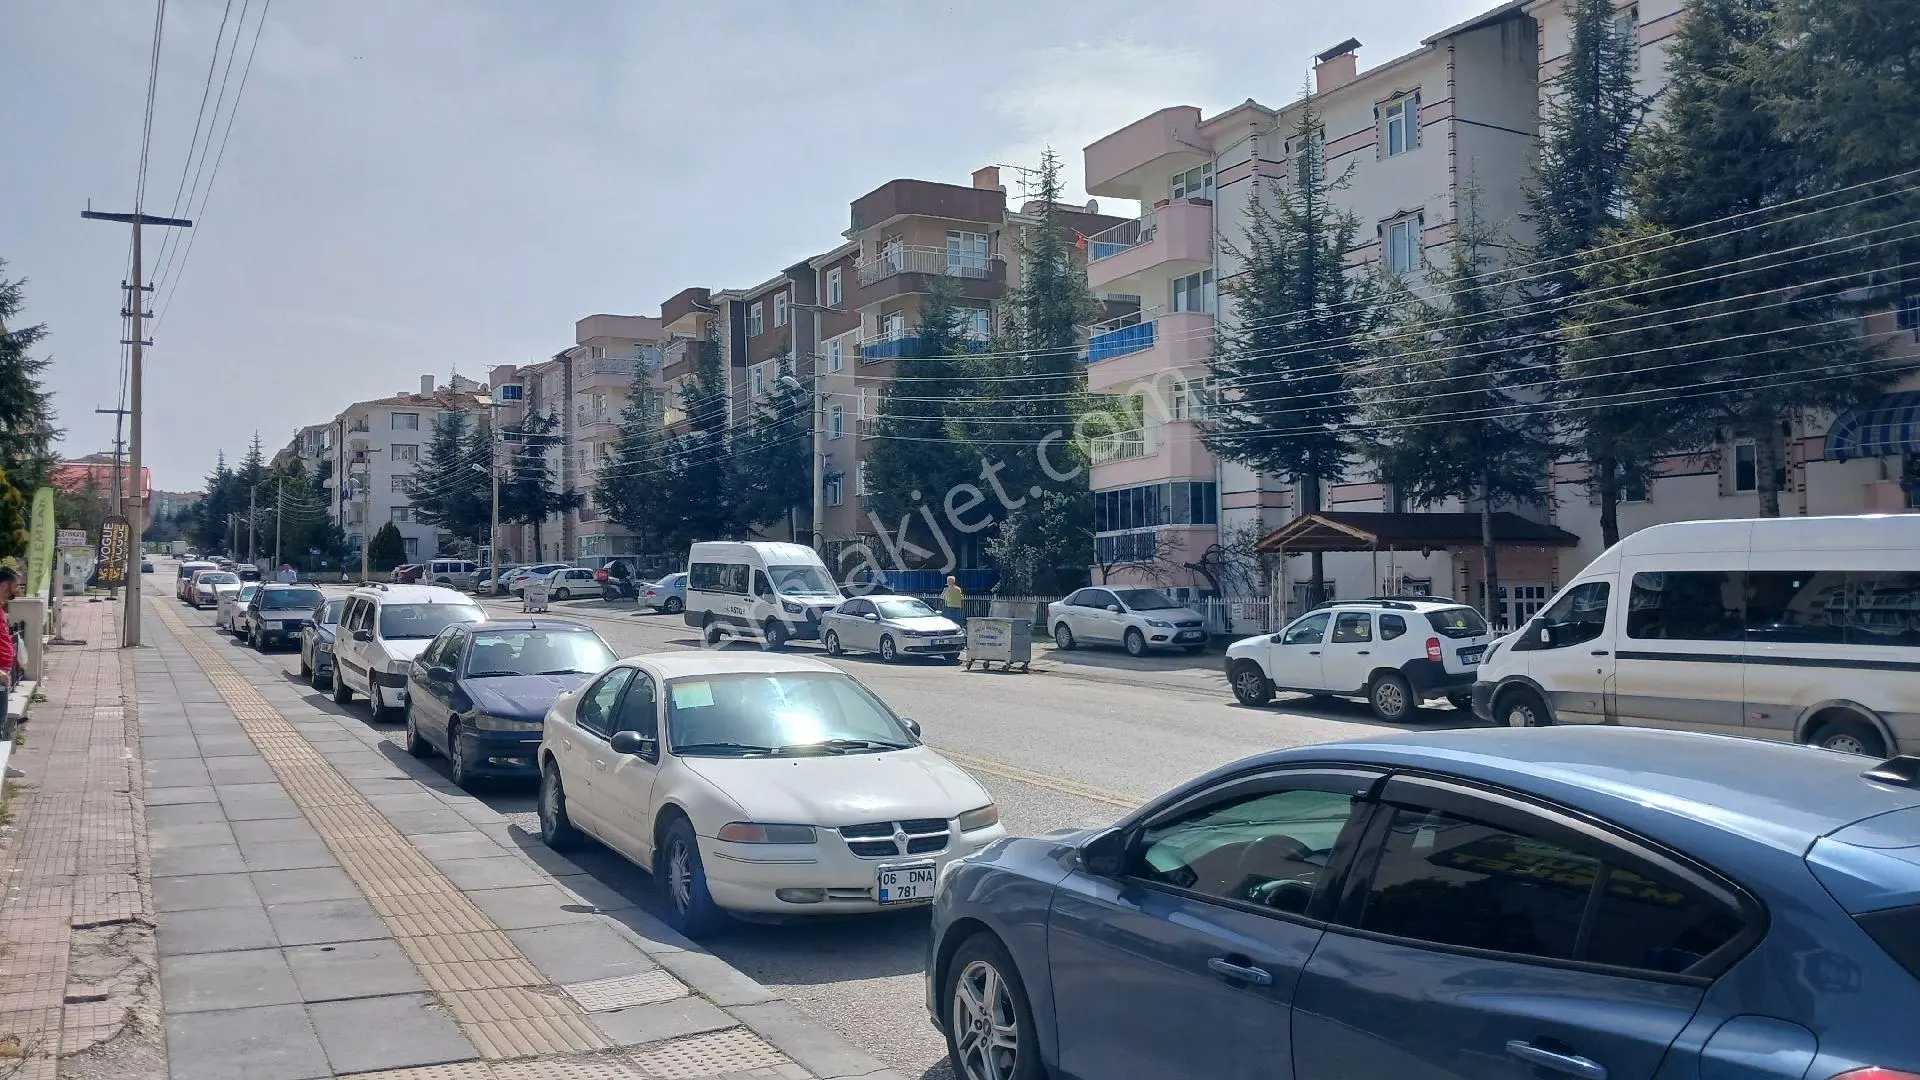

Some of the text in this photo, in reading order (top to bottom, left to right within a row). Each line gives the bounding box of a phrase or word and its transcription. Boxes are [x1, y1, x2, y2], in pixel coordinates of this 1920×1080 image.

[100, 523, 113, 562] VOGUE
[883, 870, 933, 885] 06 DNA
[897, 885, 916, 898] 781
